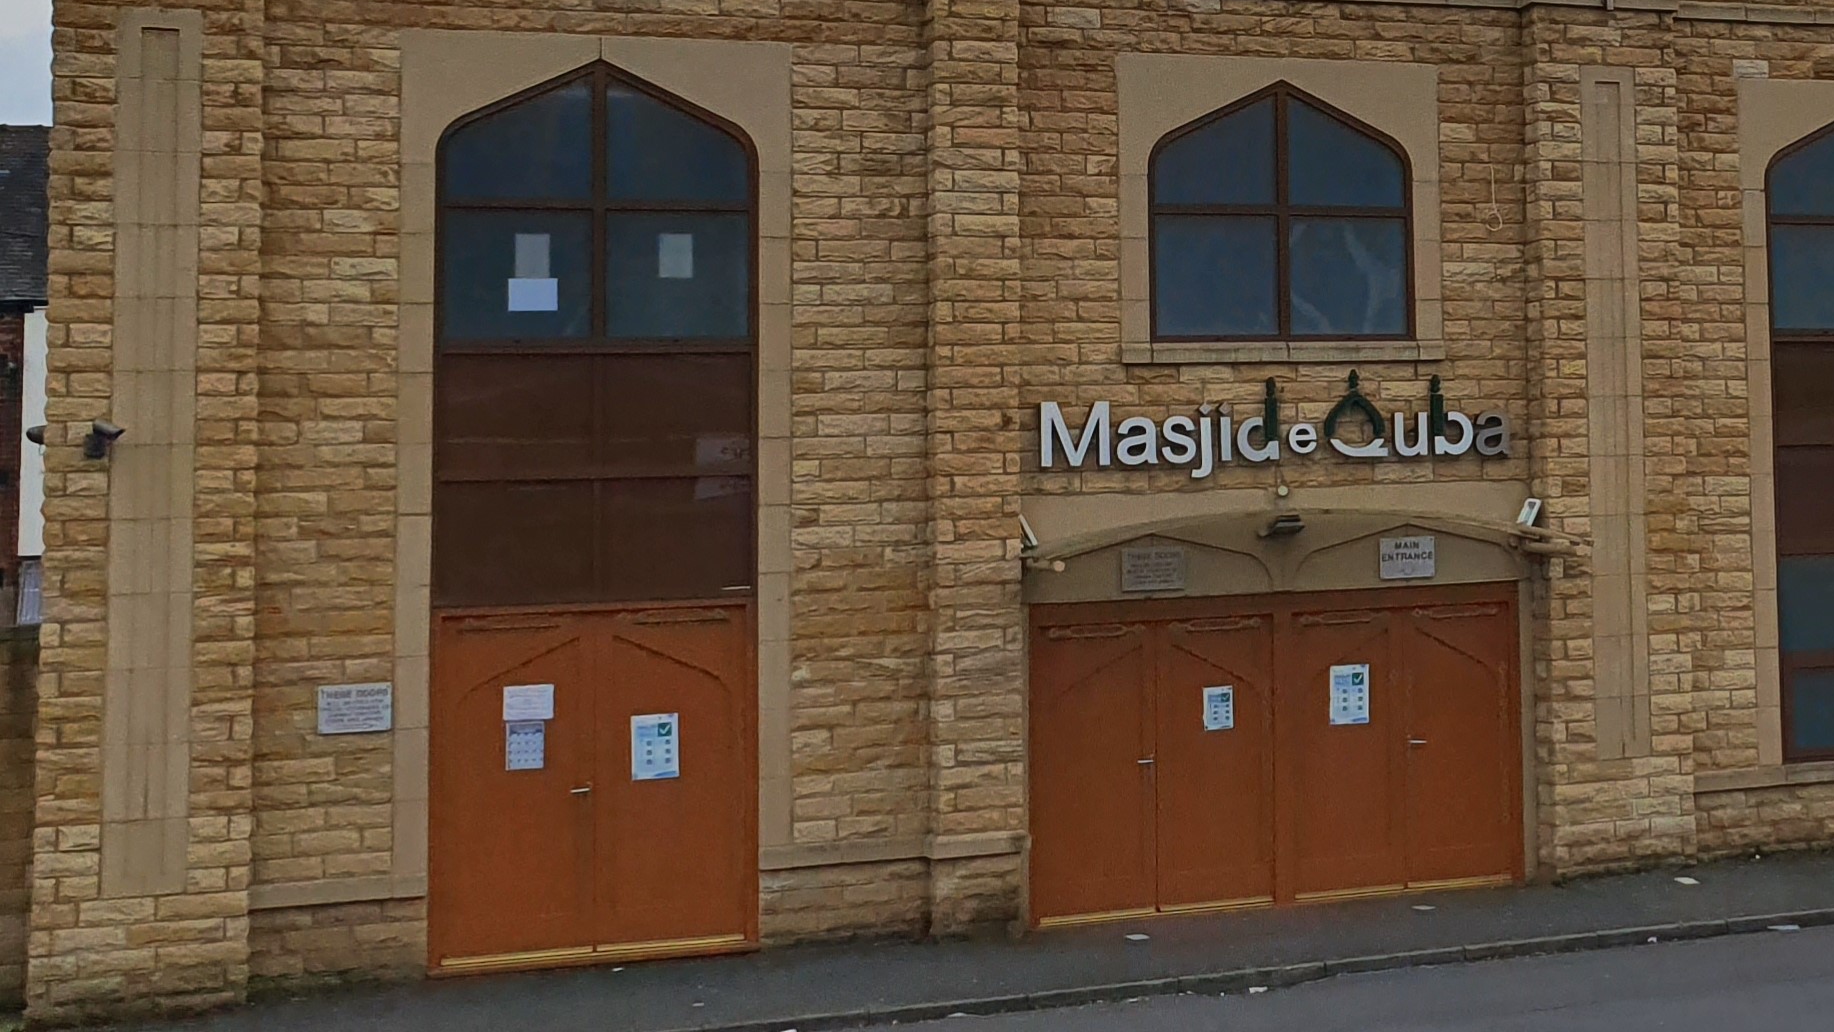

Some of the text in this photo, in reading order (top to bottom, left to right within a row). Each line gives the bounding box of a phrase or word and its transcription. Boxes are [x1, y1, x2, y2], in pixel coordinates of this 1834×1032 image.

[1040, 369, 1511, 478] Masjid e Quba
[1394, 541, 1420, 549] MAIN
[1381, 551, 1433, 562] ENTRANCE
